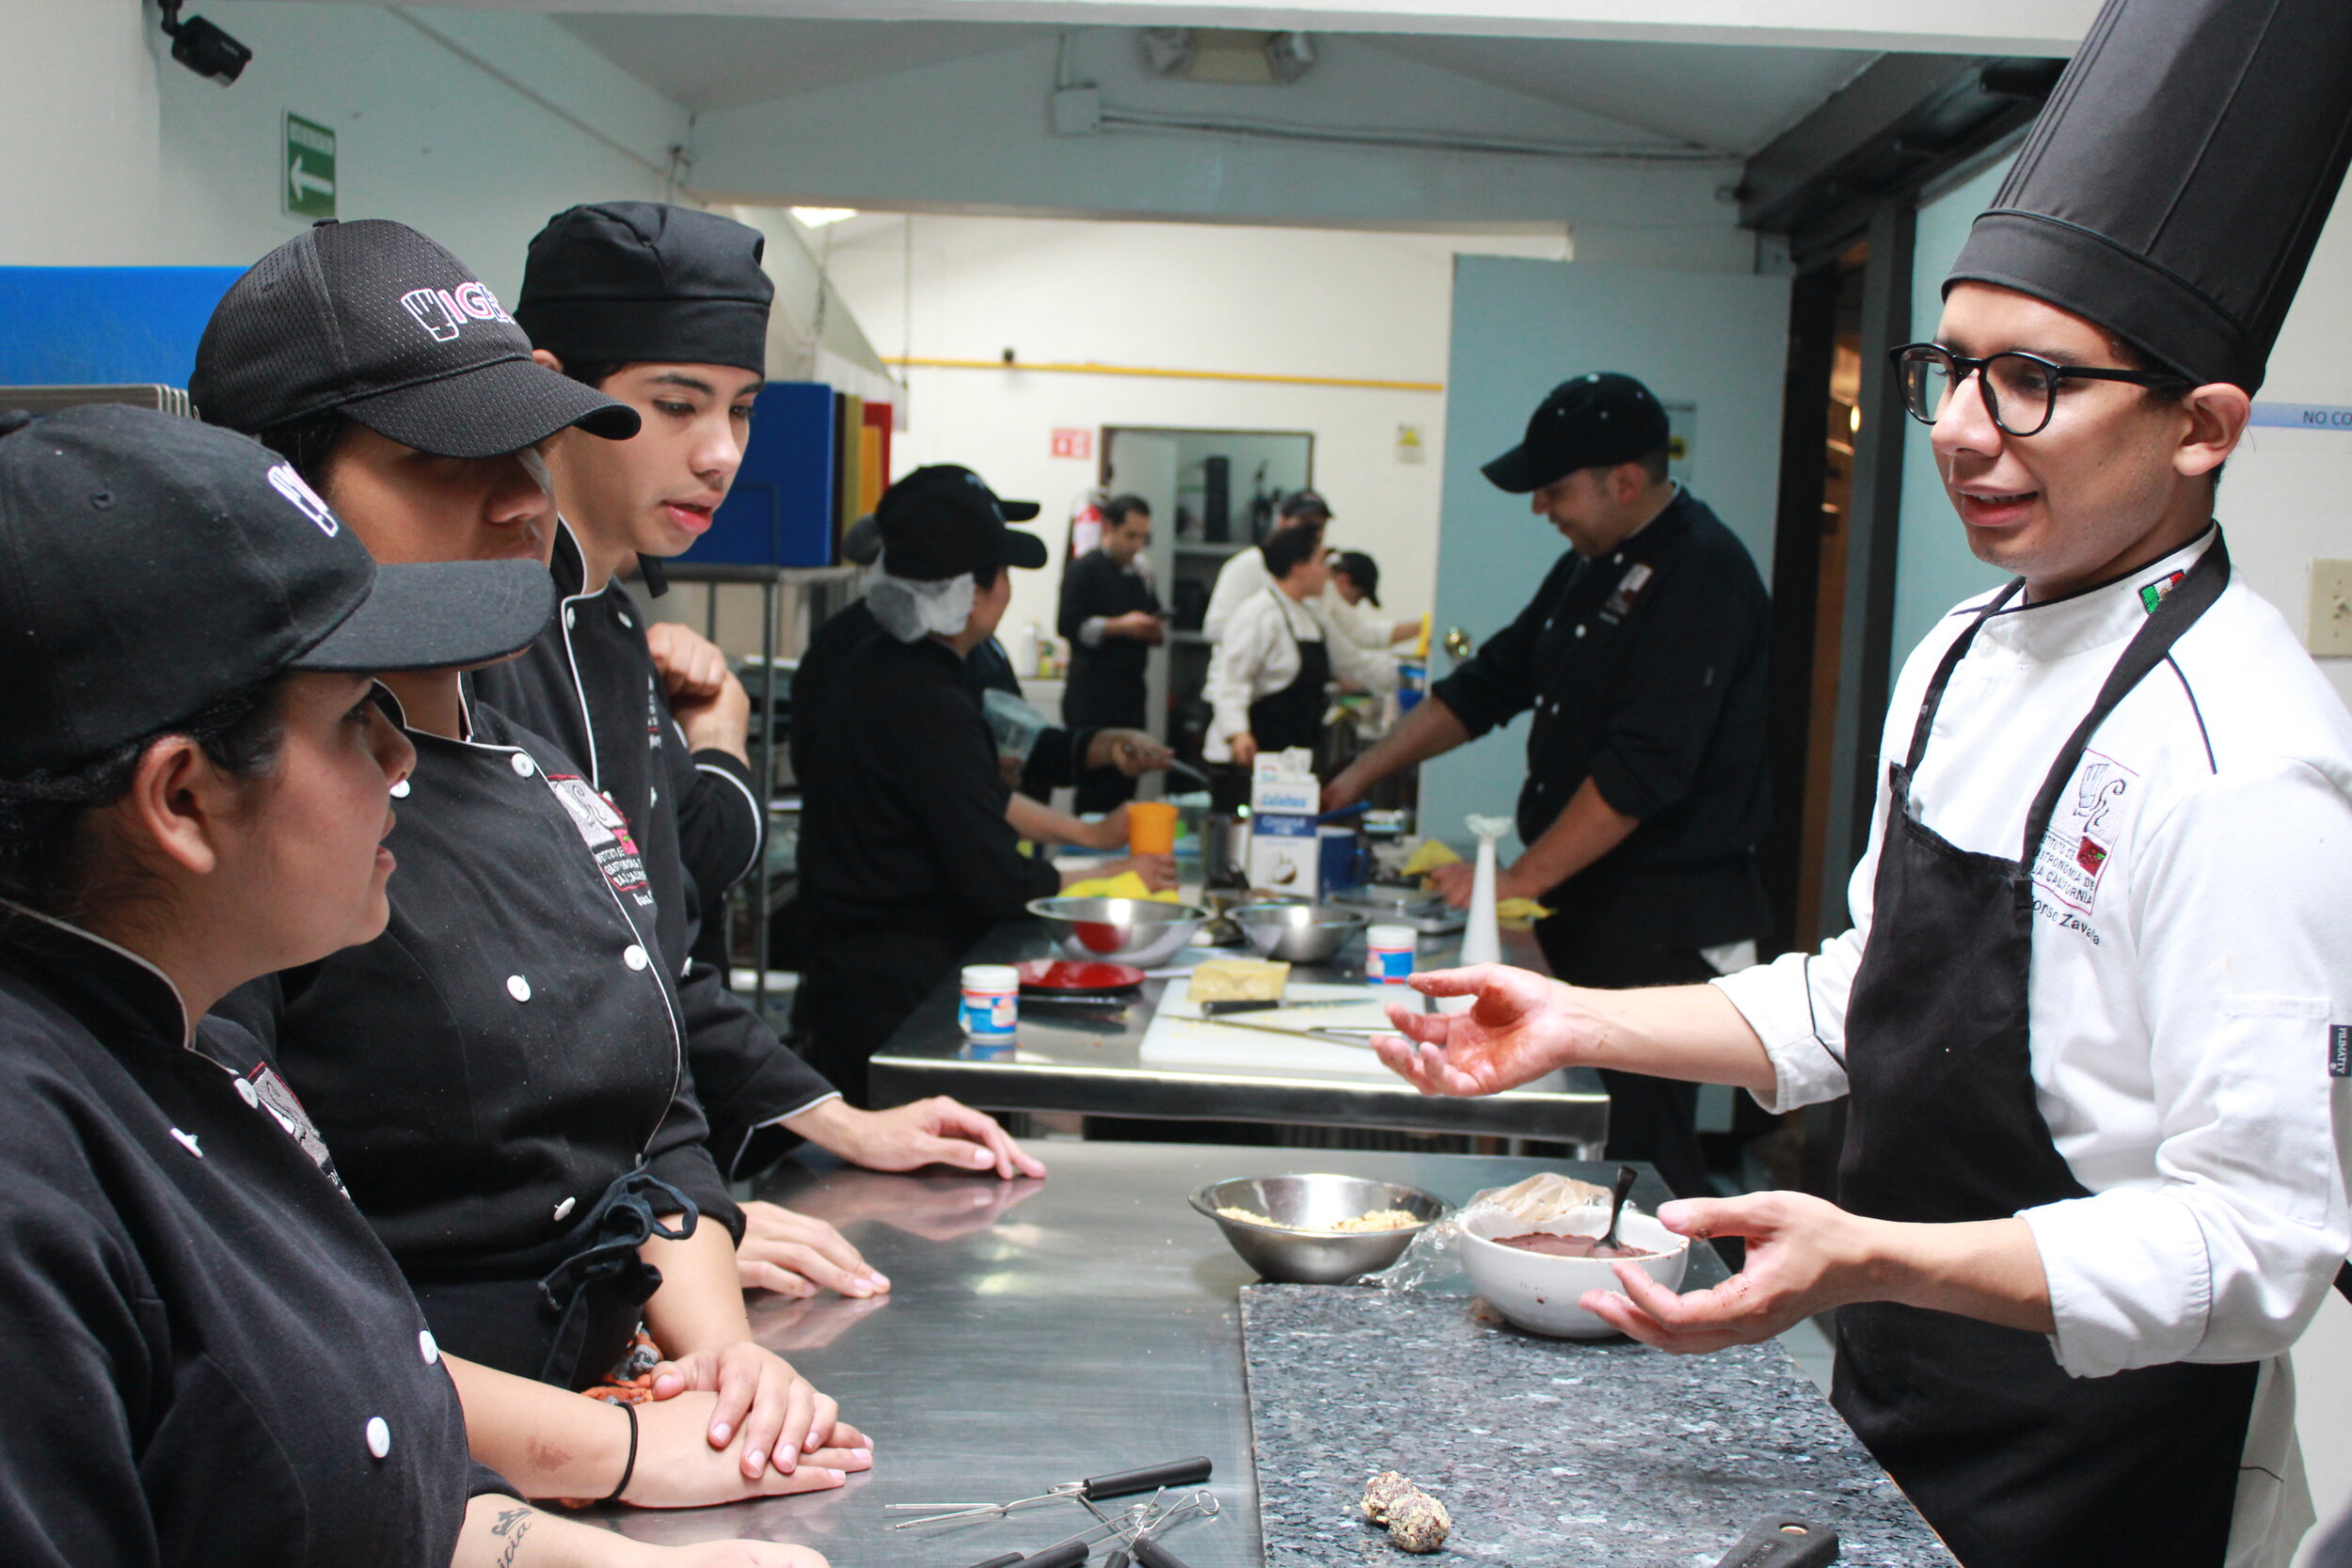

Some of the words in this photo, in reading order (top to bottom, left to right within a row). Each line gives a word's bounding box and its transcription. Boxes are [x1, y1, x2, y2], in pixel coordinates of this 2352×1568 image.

[2302, 410, 2327, 425] NO
[2045, 871, 2092, 905] CALIFORNIA
[2083, 878, 2095, 892] DE
[2032, 895, 2058, 922] onso
[2058, 912, 2100, 946] Zavala
